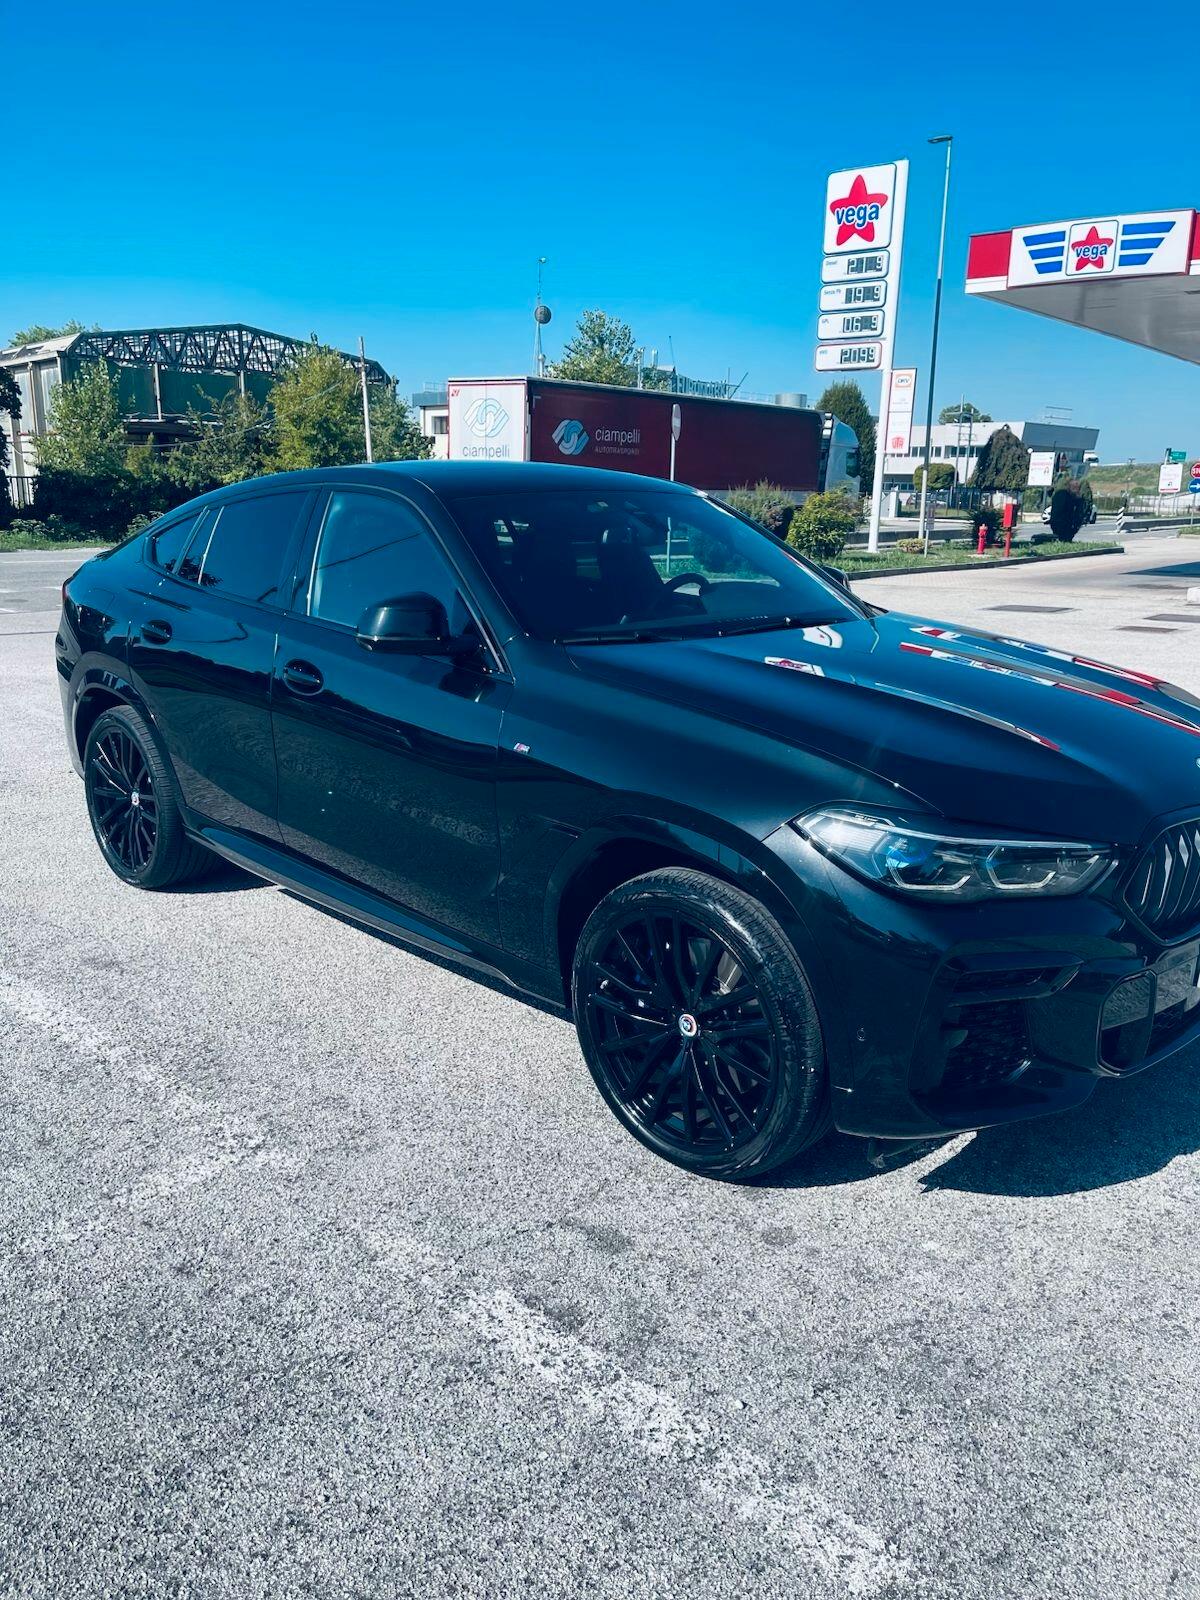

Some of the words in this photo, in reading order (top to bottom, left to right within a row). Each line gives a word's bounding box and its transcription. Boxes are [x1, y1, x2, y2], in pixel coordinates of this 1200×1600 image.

[836, 204, 880, 228] vega
[1075, 243, 1108, 260] vega
[842, 347, 875, 364] 2099
[595, 428, 641, 446] ciampelli
[462, 443, 510, 459] ciampelli
